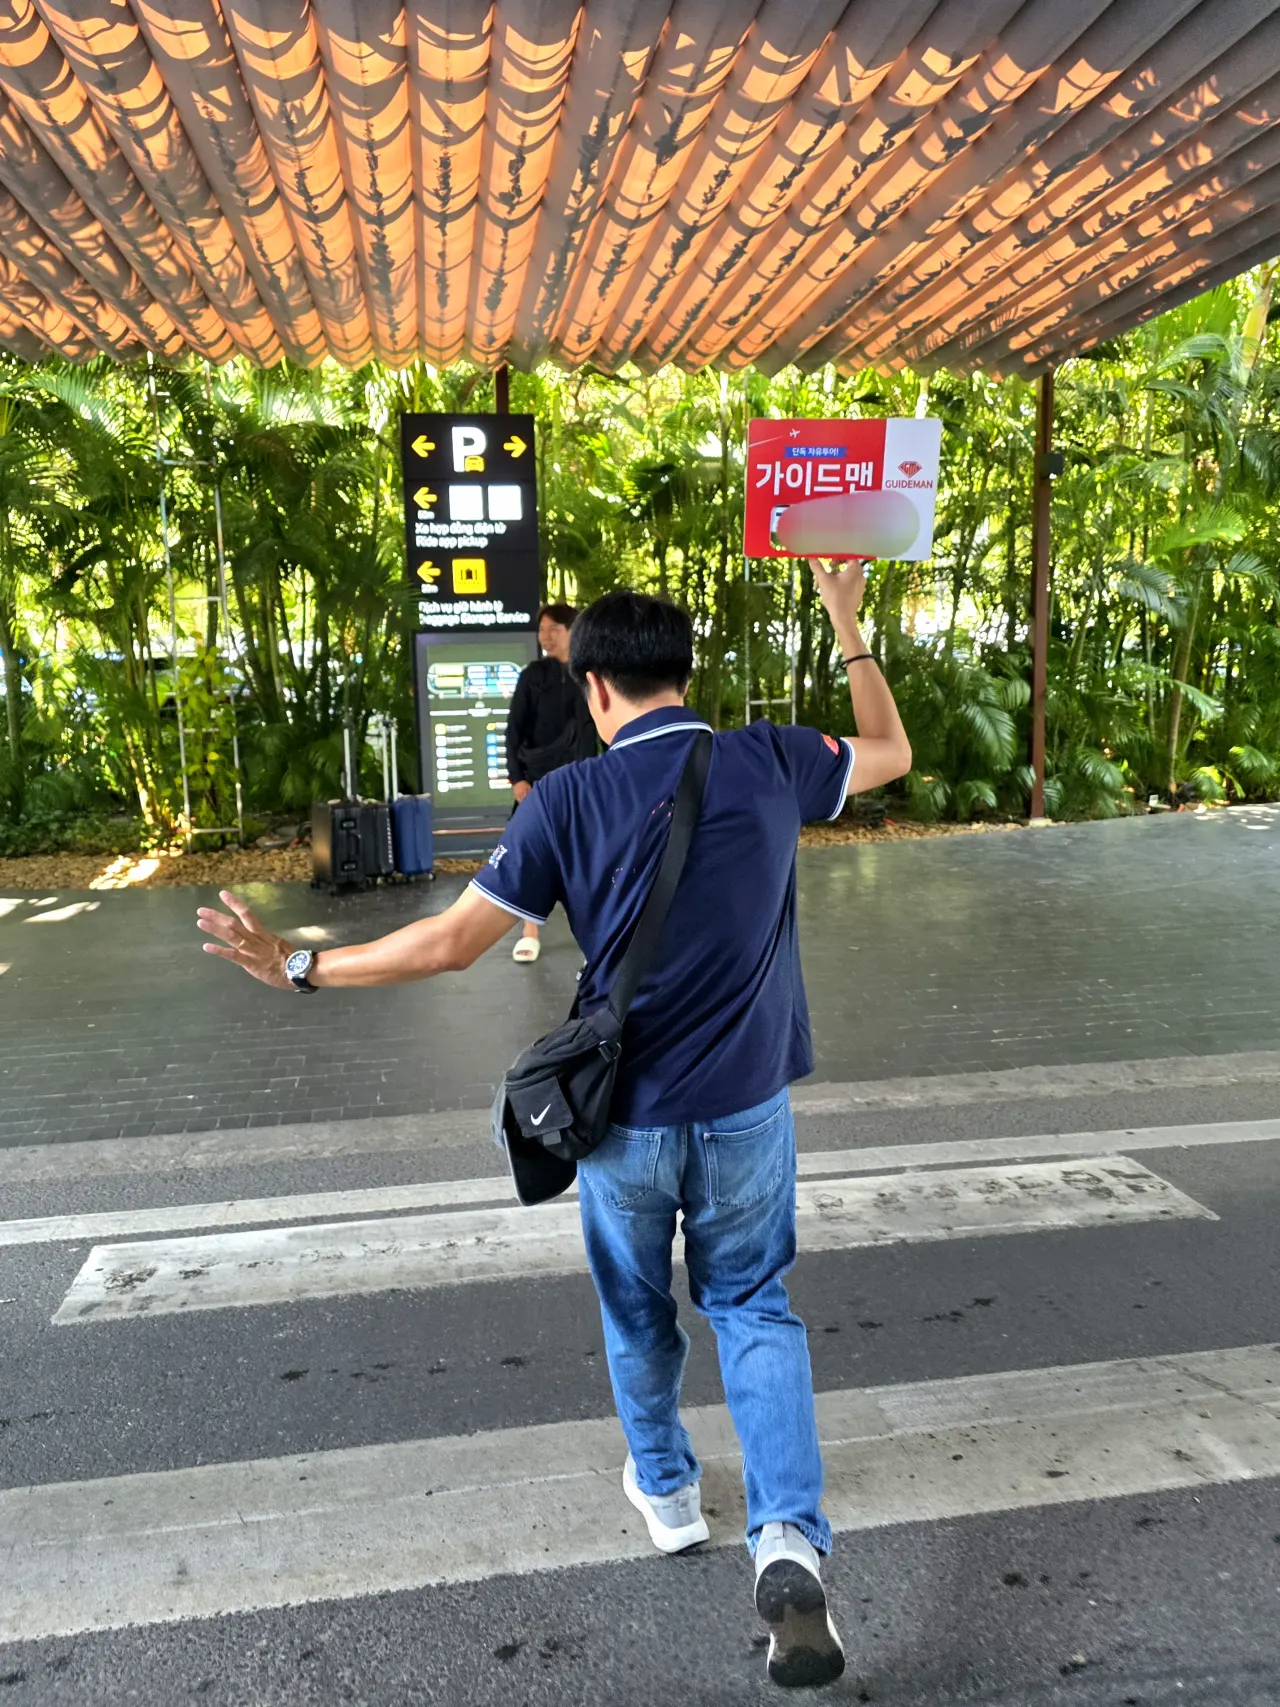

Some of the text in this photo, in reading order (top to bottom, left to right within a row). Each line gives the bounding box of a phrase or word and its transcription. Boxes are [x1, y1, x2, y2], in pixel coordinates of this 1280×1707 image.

[452, 426, 487, 472] P
[792, 447, 839, 457] 단독 자유투어!
[755, 461, 874, 496] 가이드맨
[885, 479, 933, 489] GUIDEMAN
[415, 522, 429, 534] Xe
[429, 522, 449, 535] hợp
[416, 535, 488, 548] Ride app pickup
[440, 603, 453, 614] vụ
[460, 612, 495, 625] Storage
[496, 611, 530, 623] Service
